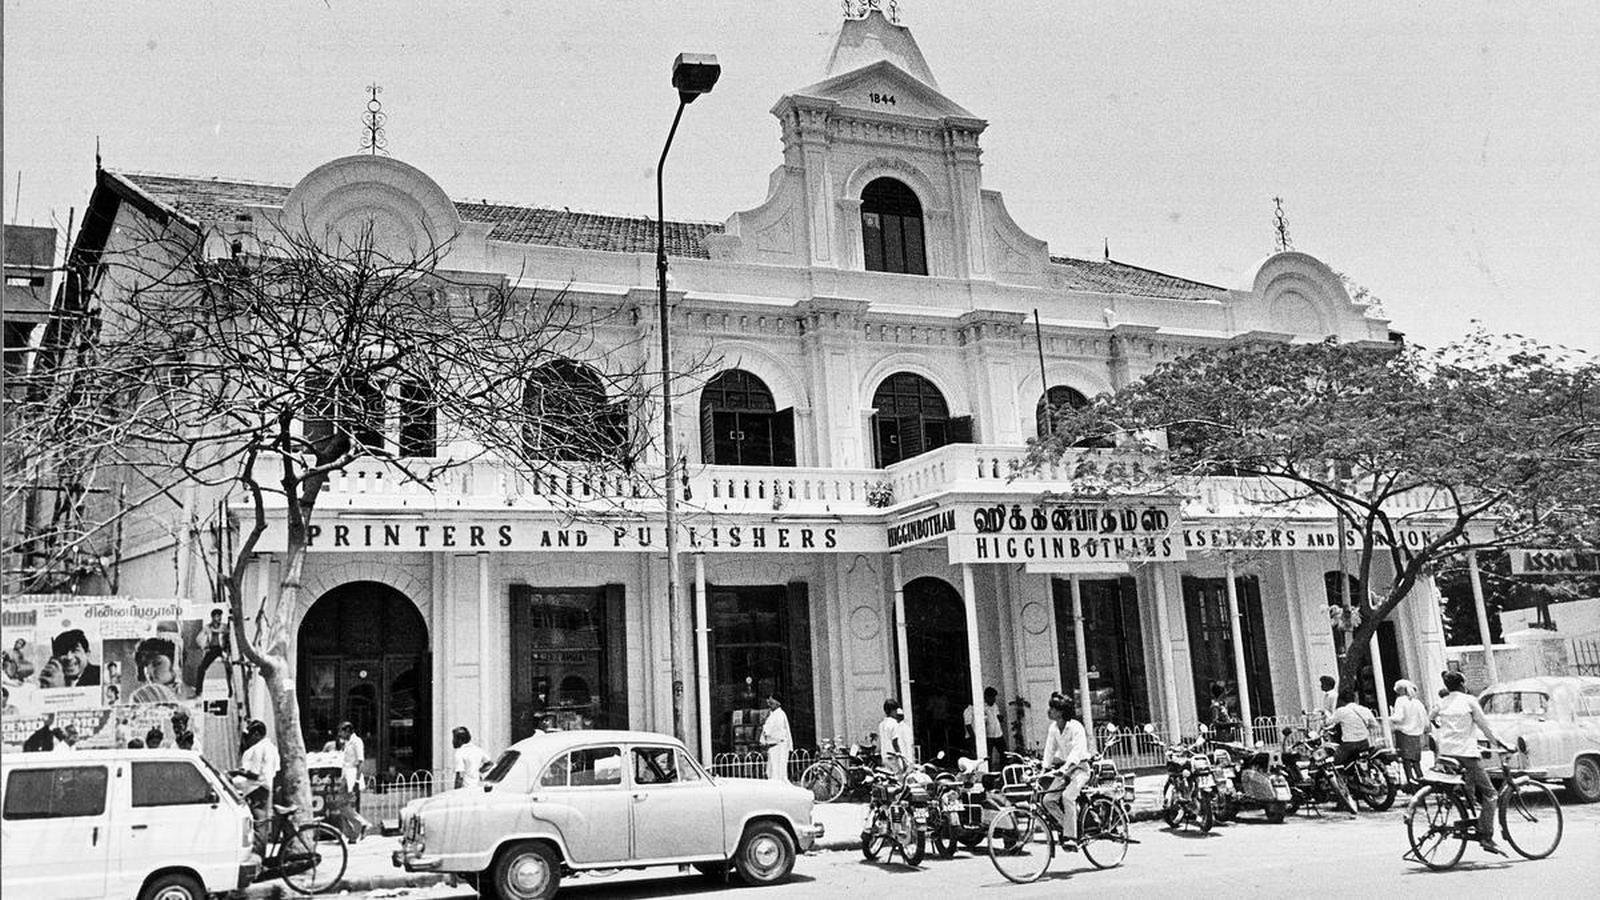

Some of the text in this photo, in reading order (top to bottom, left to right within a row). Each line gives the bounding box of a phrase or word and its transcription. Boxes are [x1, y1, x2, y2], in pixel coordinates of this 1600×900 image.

[869, 92, 896, 106] 1844
[307, 525, 512, 547] PRINTERS
[541, 530, 588, 547] AND
[1307, 533, 1335, 547] AND
